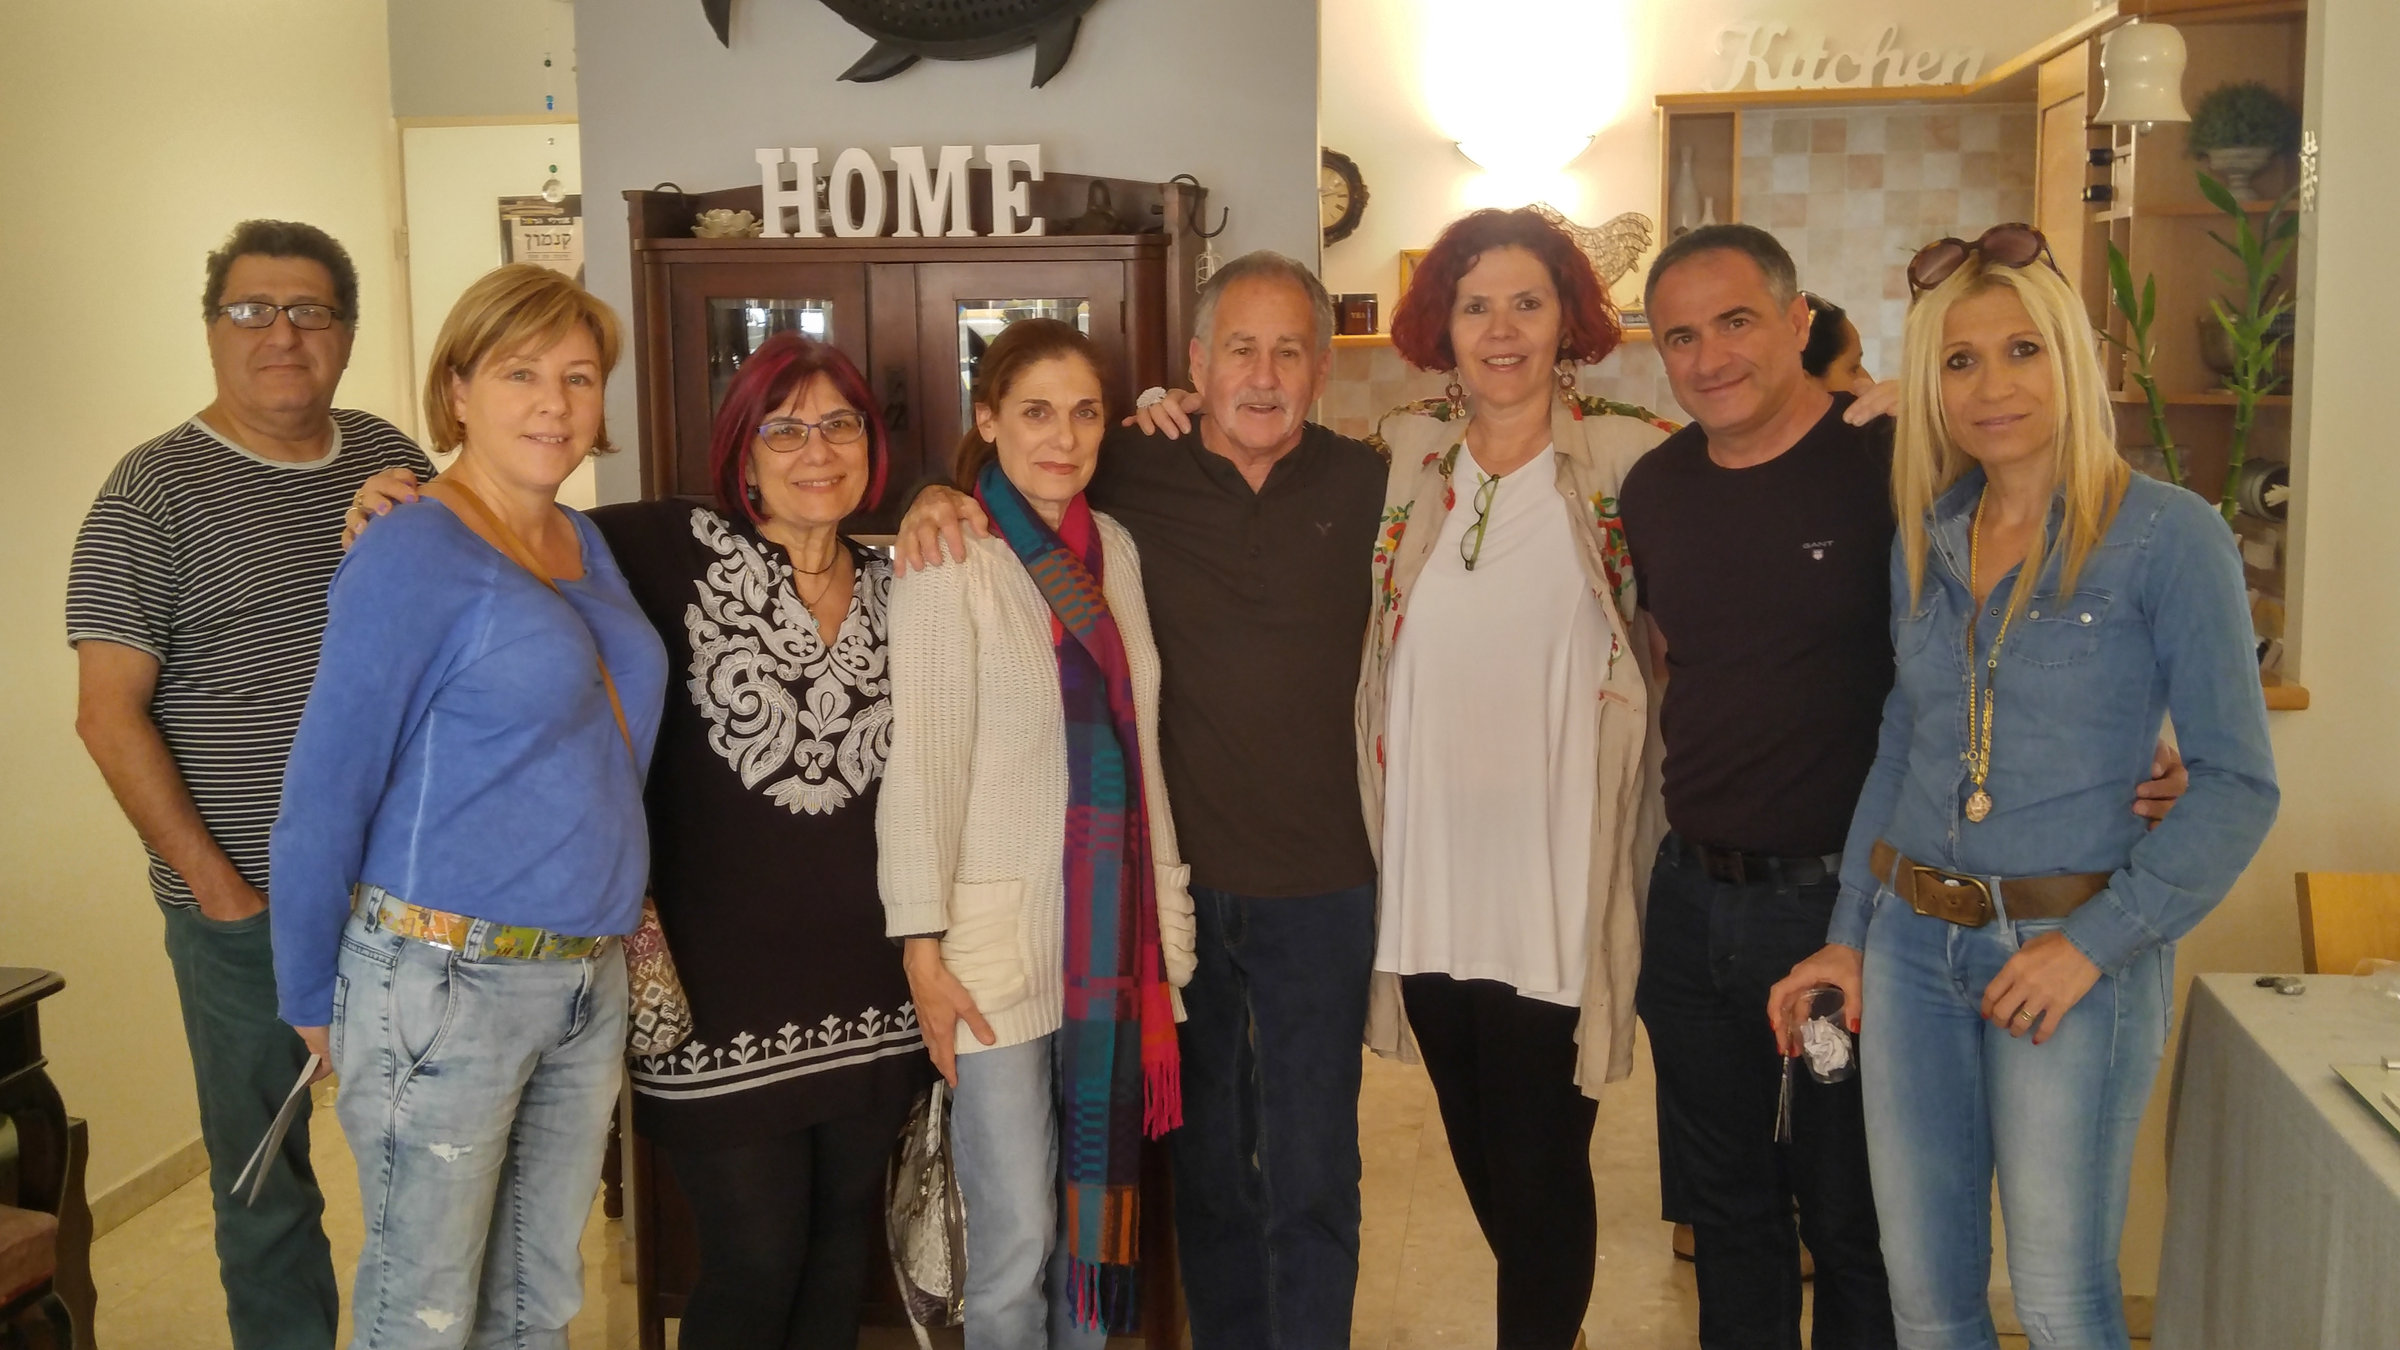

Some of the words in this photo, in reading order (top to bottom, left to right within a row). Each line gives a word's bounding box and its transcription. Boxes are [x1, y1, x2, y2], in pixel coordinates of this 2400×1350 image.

[1702, 20, 1985, 92] Kitchen
[755, 143, 1046, 238] HOME
[1802, 540, 1834, 549] GANT
